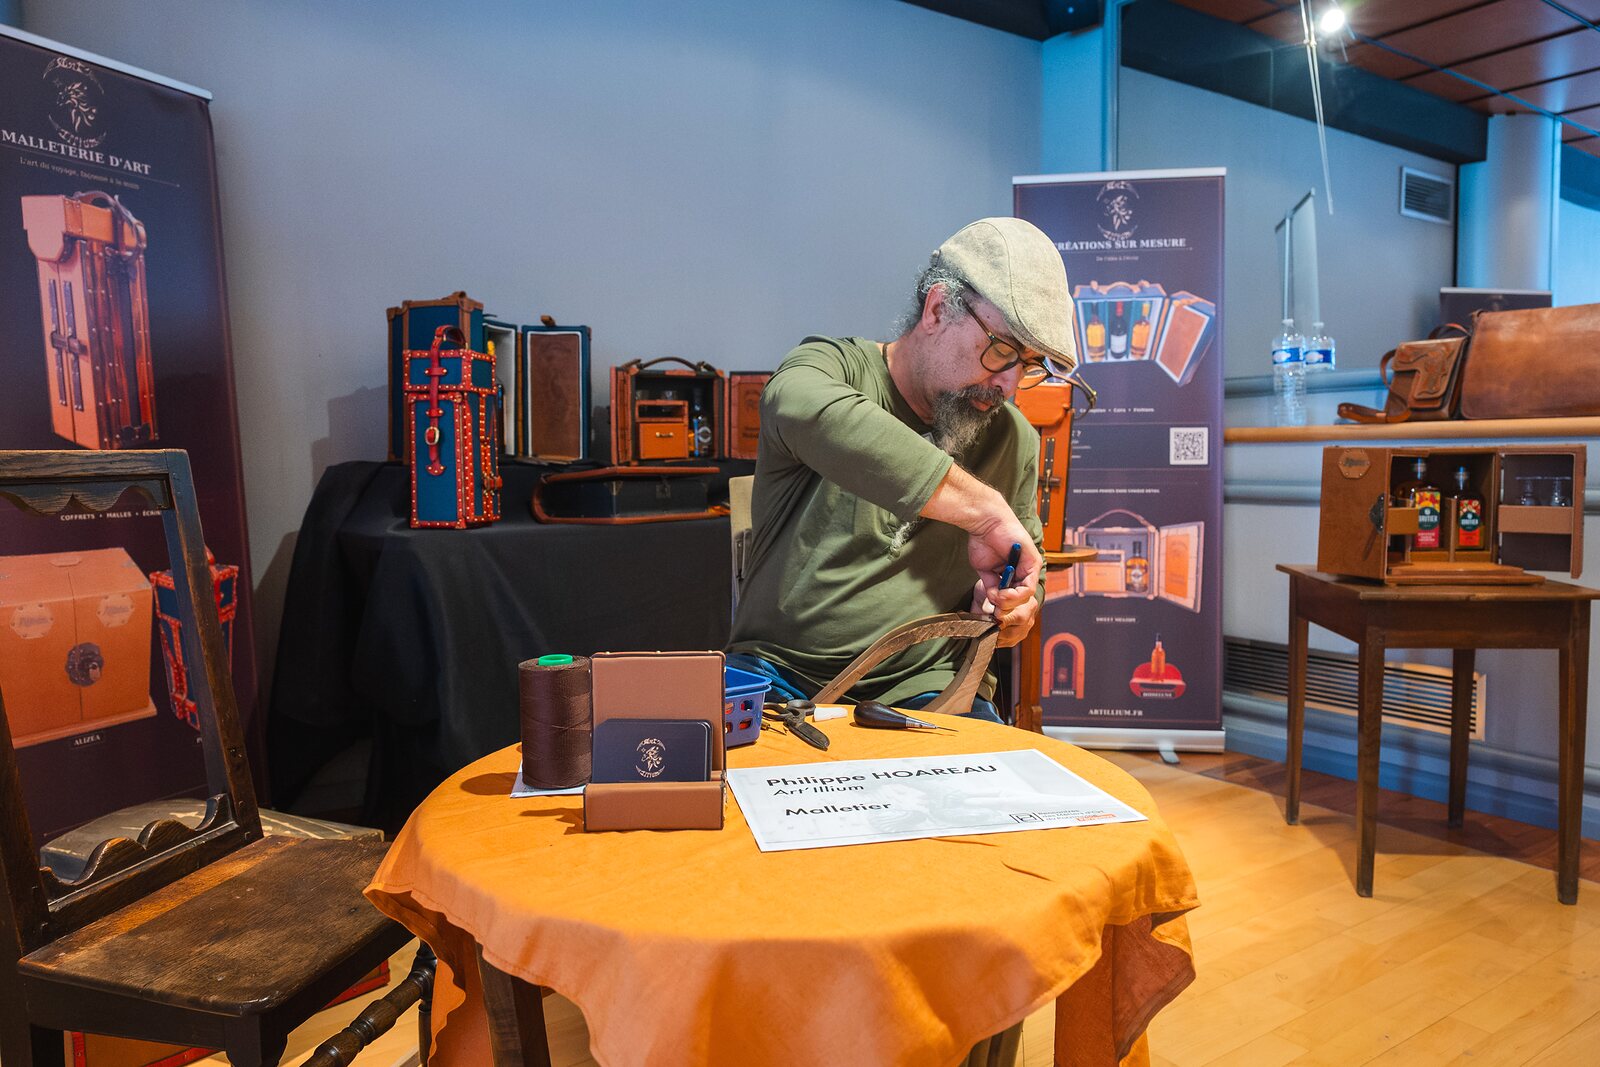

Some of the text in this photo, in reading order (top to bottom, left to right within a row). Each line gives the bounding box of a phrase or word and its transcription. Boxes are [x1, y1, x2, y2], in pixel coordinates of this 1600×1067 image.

[1, 129, 151, 175] MALLETERIE D'ART
[20, 156, 38, 167] L'art
[1055, 238, 1186, 251] RÉATIONS SUR MESURE
[60, 513, 96, 521] COFFRETS
[106, 511, 132, 519] MALLES
[1088, 708, 1143, 716] ARTILLIUM.FR
[766, 765, 998, 787] Philippe HOAREAU
[773, 785, 864, 796] Art'Illium
[785, 802, 892, 816] Malletier
